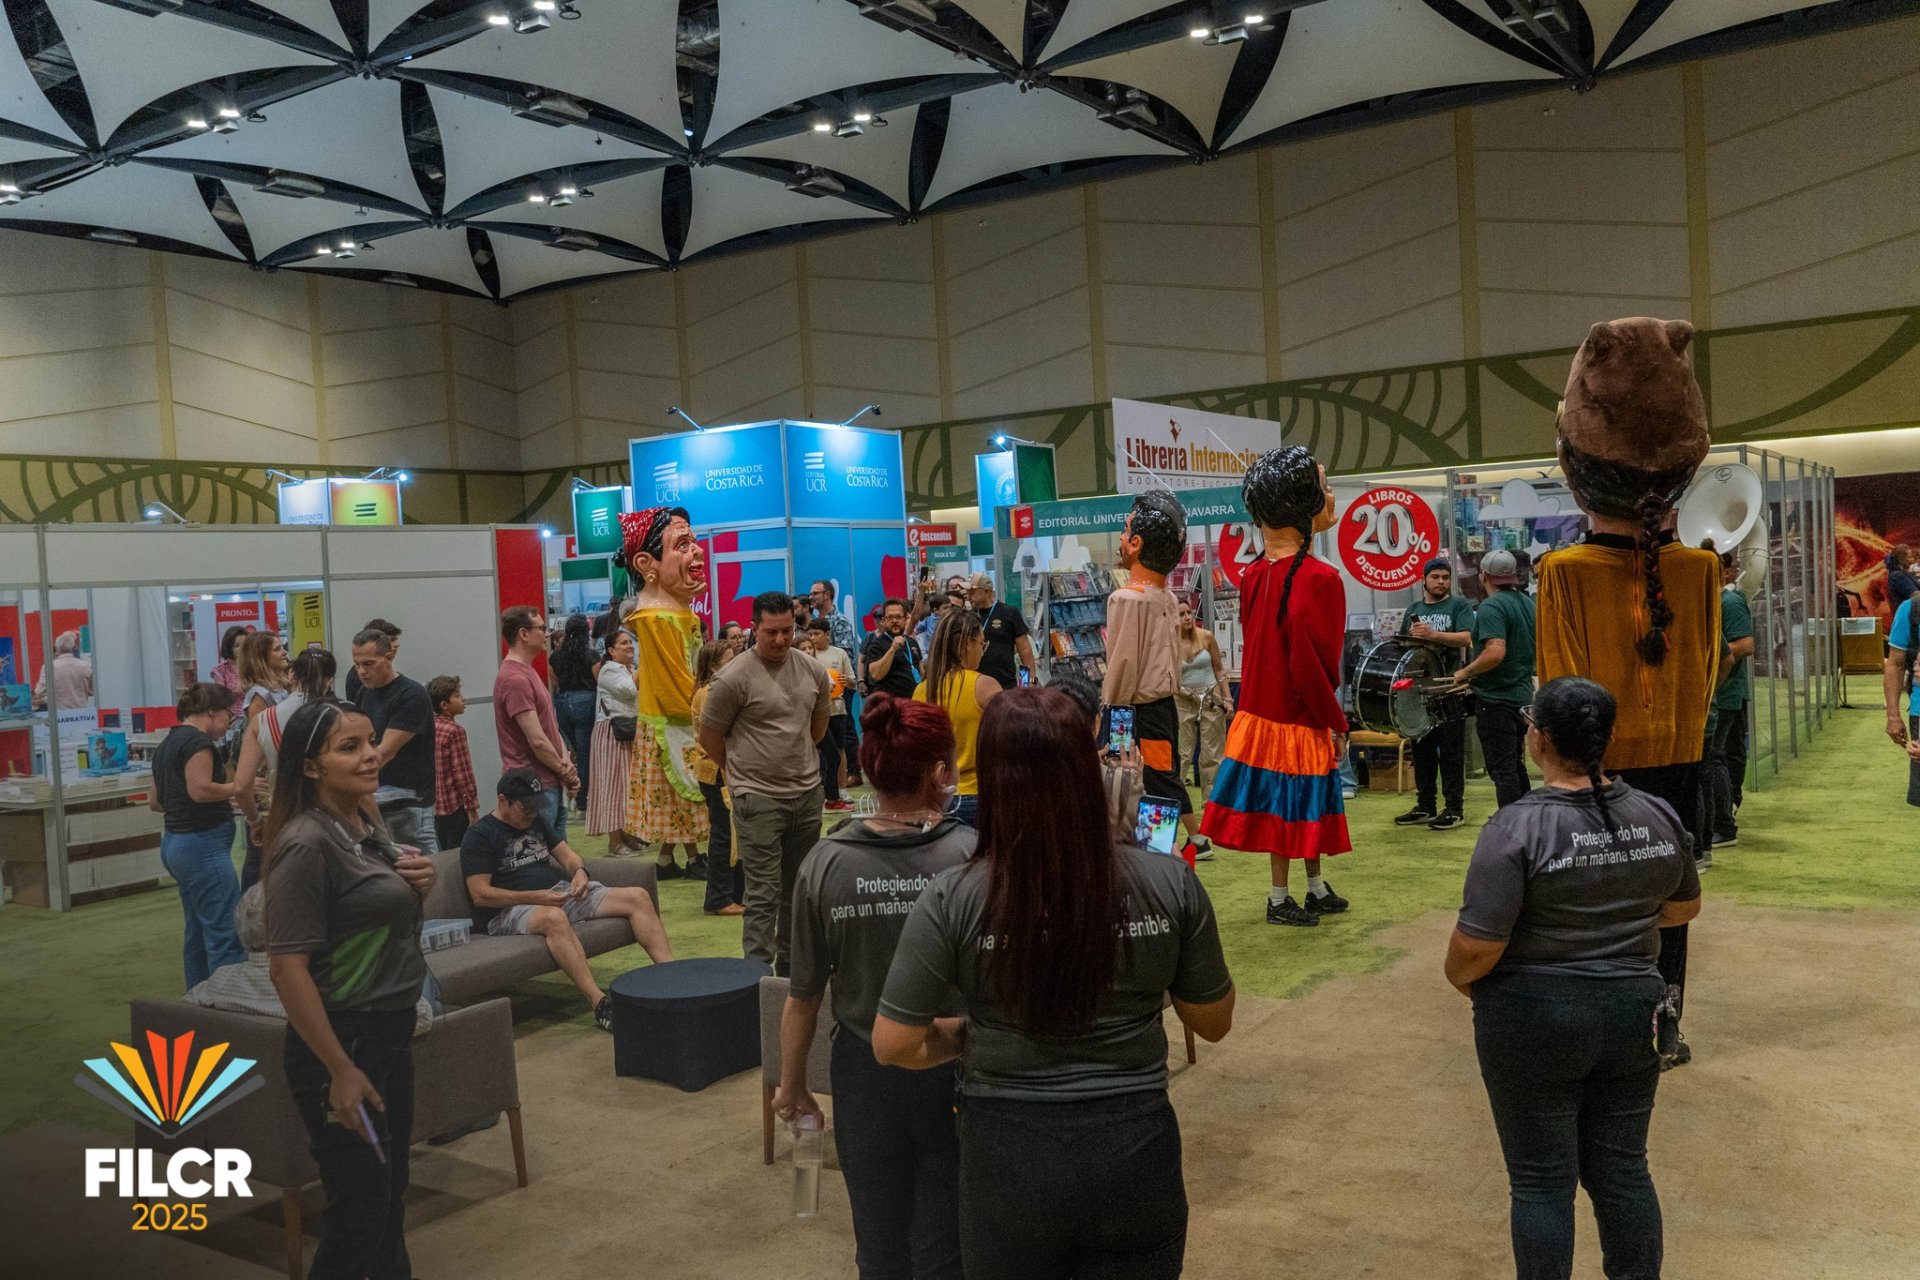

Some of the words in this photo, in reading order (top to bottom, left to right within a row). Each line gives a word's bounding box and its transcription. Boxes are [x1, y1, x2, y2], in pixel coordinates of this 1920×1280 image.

[705, 465, 752, 478] UNIVERSIDAD
[753, 464, 764, 473] DE
[846, 466, 880, 475] UNIVERSIDAD
[881, 468, 888, 476] DE
[706, 477, 738, 491] COSTA
[739, 473, 764, 488] RICA
[806, 478, 827, 492] UCR
[846, 474, 871, 487] COSTA
[871, 475, 889, 488] RICA
[656, 488, 681, 503] UCR
[1368, 490, 1414, 505] LIBROS
[1038, 516, 1092, 529] EDITORIAL
[592, 526, 610, 537] UCR
[1355, 553, 1420, 580] DESCUENTO
[304, 616, 321, 628] UCR
[57, 715, 96, 724] NARRATIVA
[1631, 823, 1650, 842] hoy
[1548, 857, 1573, 872] para
[1575, 855, 1588, 867] un
[1589, 849, 1628, 866] mañana
[1629, 839, 1676, 861] sostenible
[856, 873, 929, 896] Protegiendo
[831, 905, 856, 923] para
[858, 903, 874, 917] un
